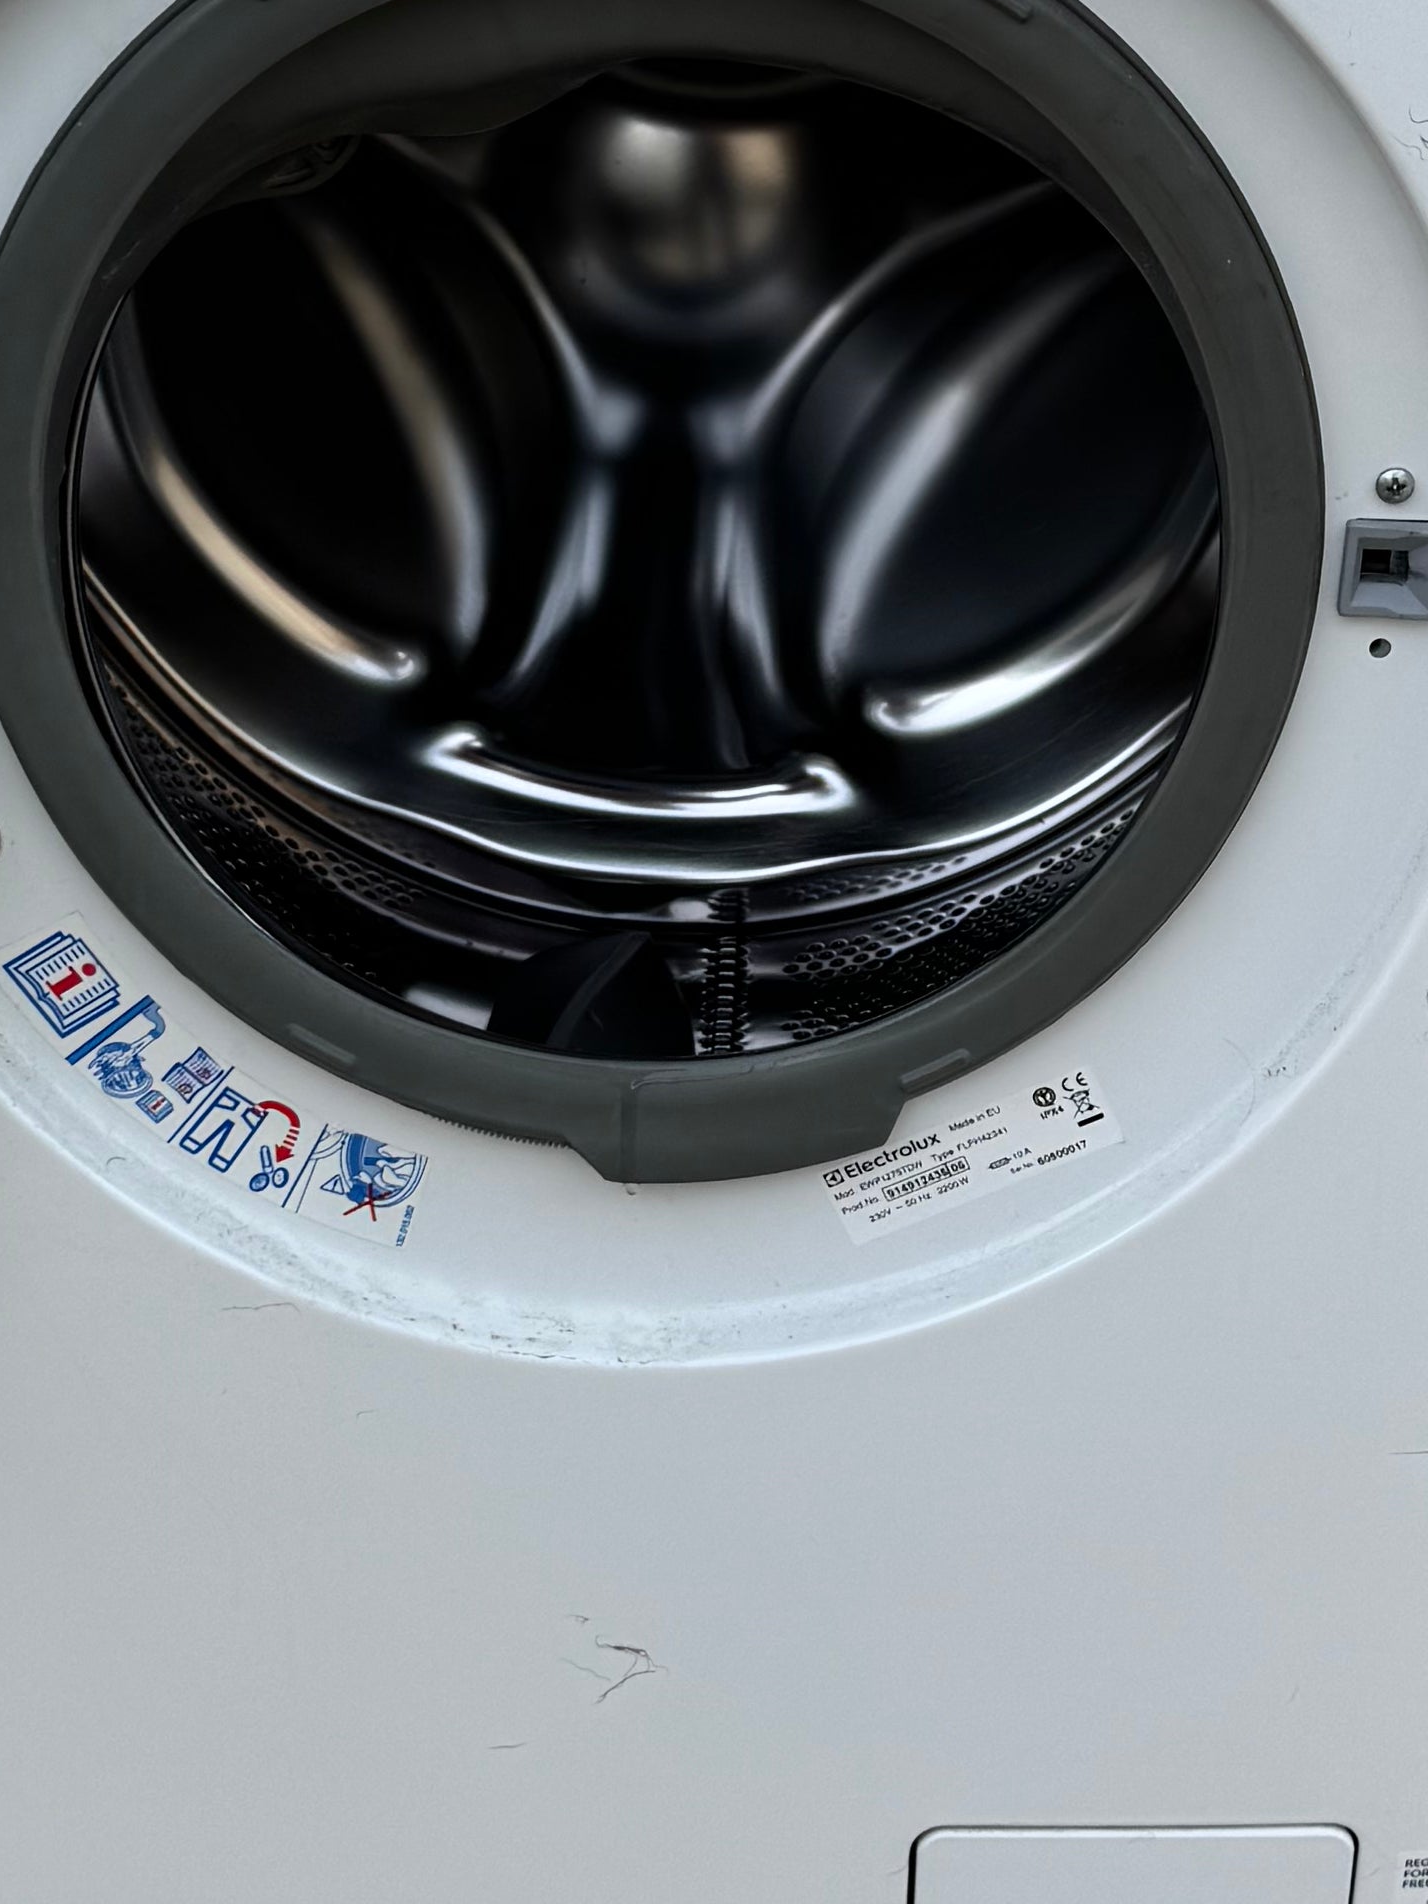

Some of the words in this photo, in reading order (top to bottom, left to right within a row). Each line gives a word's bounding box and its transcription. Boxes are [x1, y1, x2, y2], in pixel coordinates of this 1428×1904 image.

[976, 1113, 985, 1121] in
[987, 1106, 1001, 1117] EU
[844, 1134, 941, 1178] Electrolux
[1404, 1868, 1428, 1877] FOR
